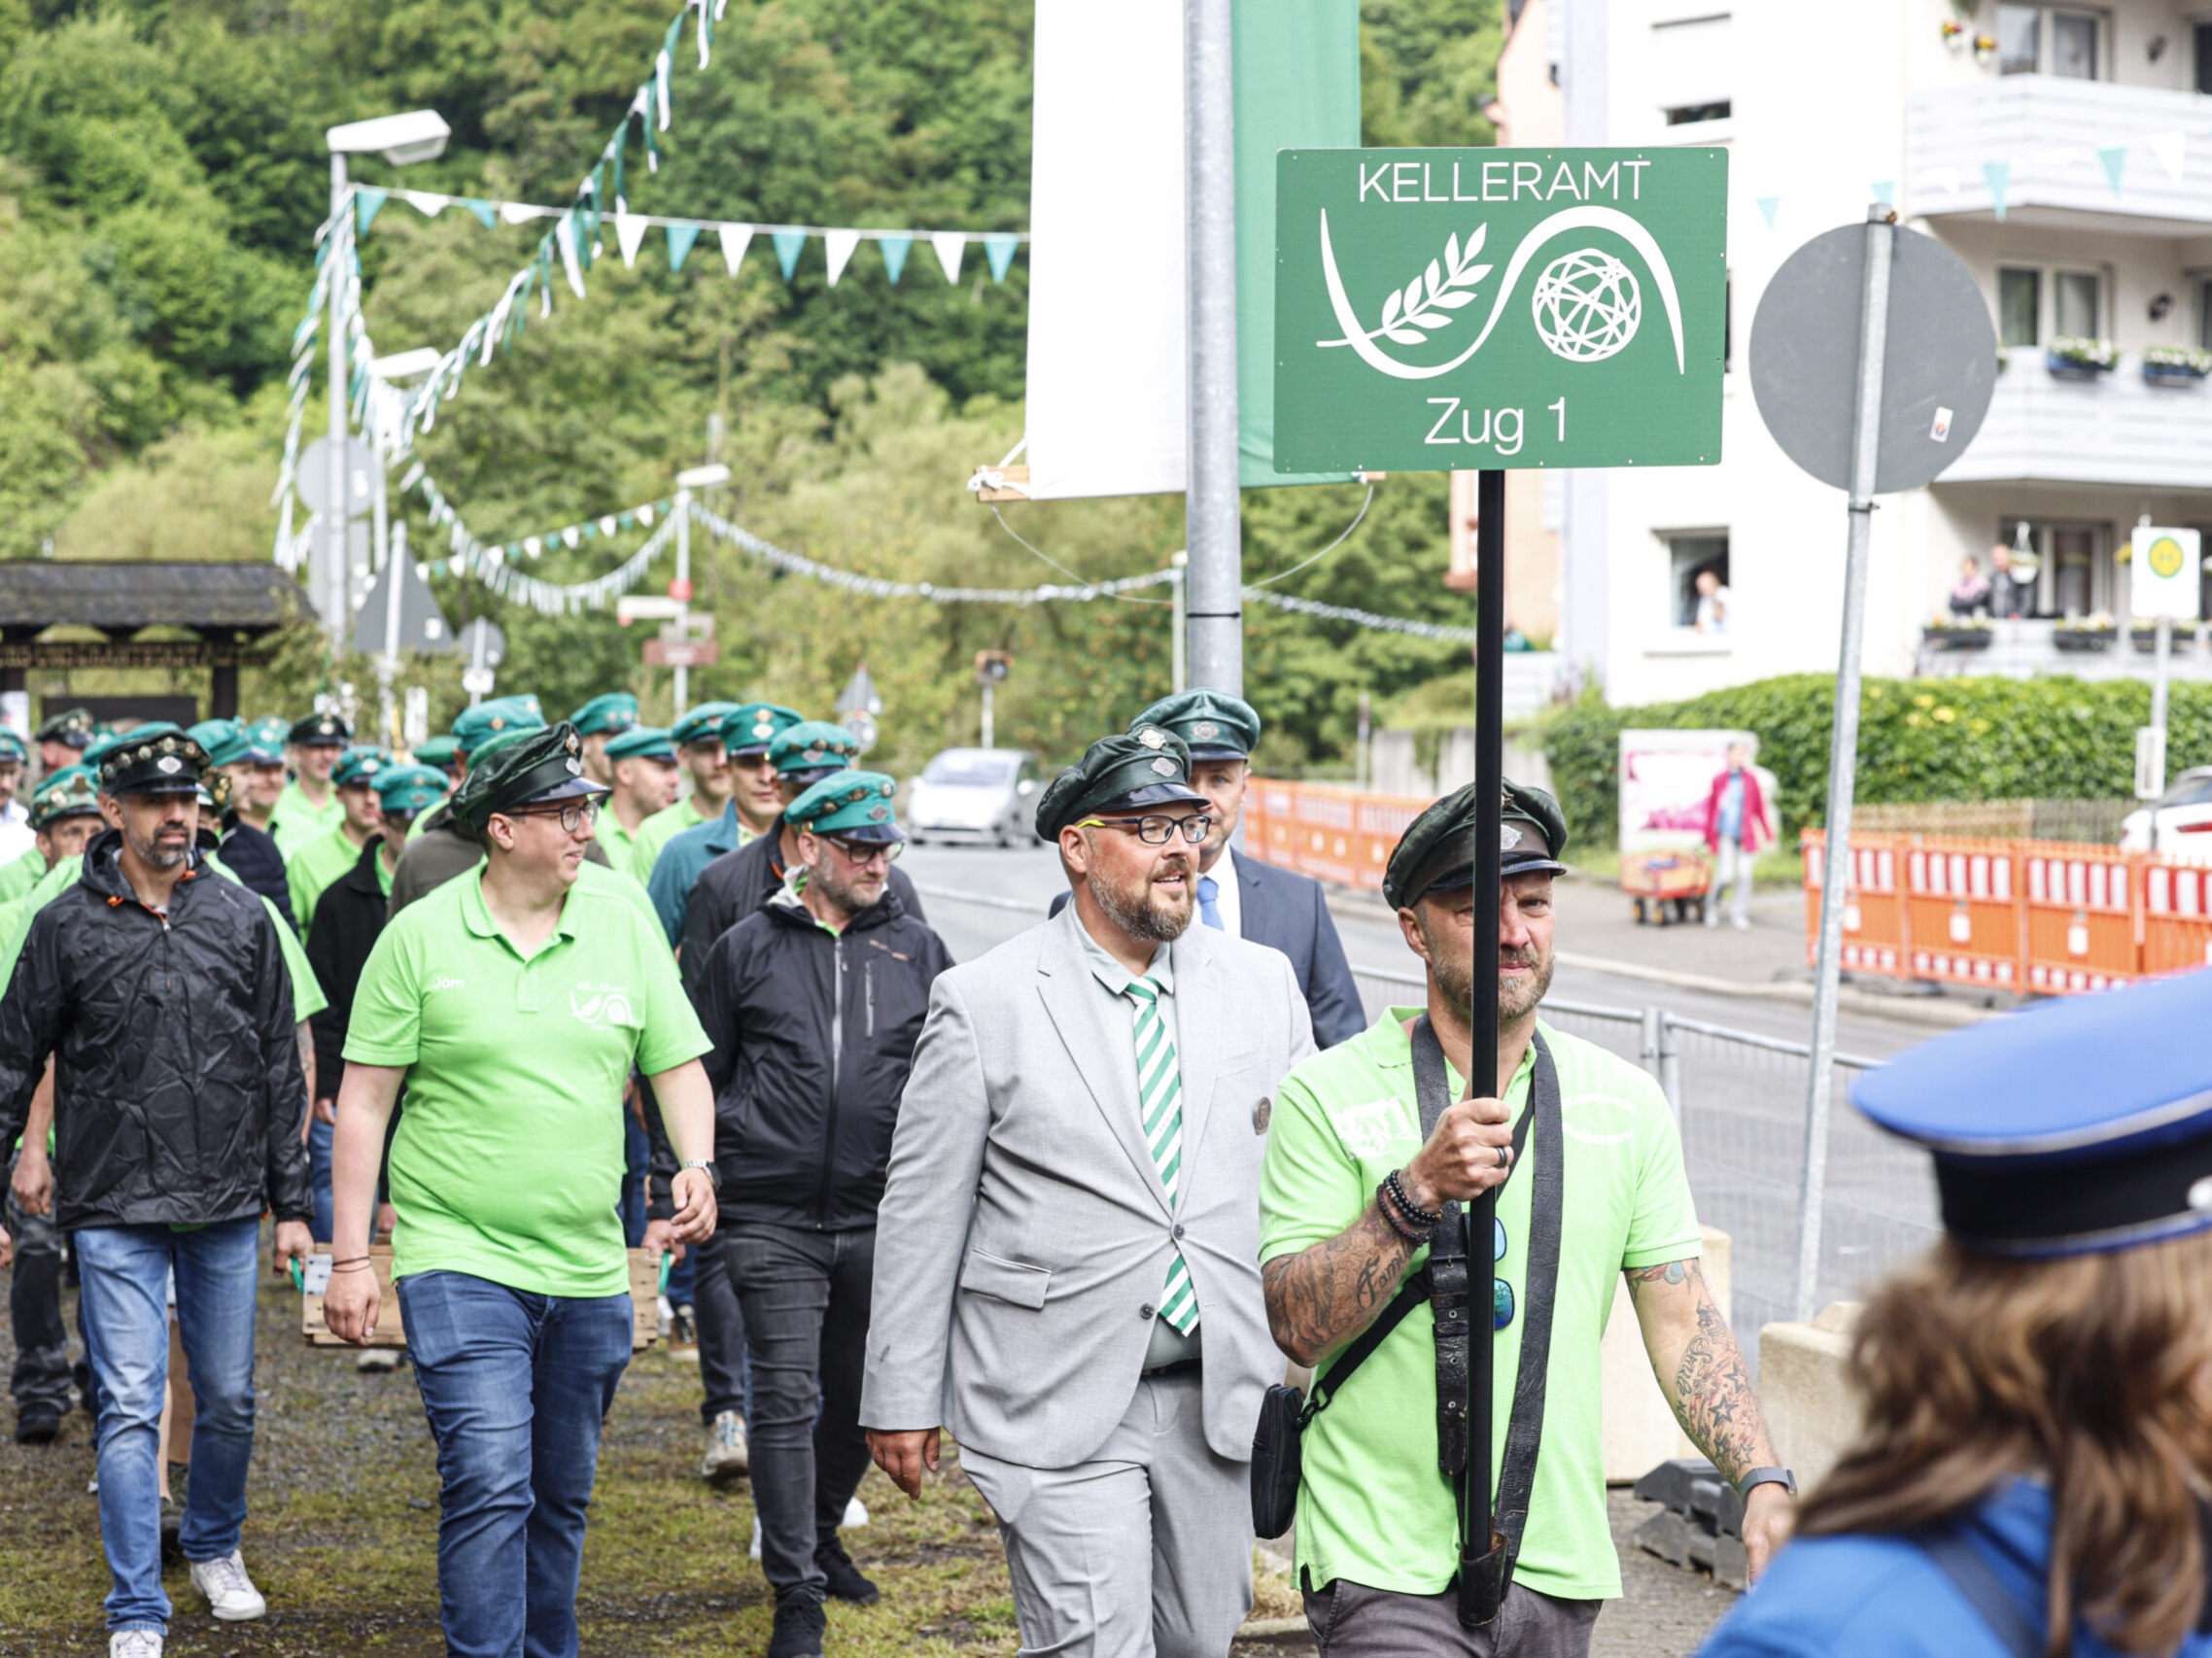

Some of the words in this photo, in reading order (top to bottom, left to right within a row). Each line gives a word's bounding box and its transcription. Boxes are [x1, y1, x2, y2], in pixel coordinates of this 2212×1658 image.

[1359, 159, 1652, 203] KELLERAMT
[1424, 397, 1525, 456] Zug
[1547, 396, 1566, 442] 1
